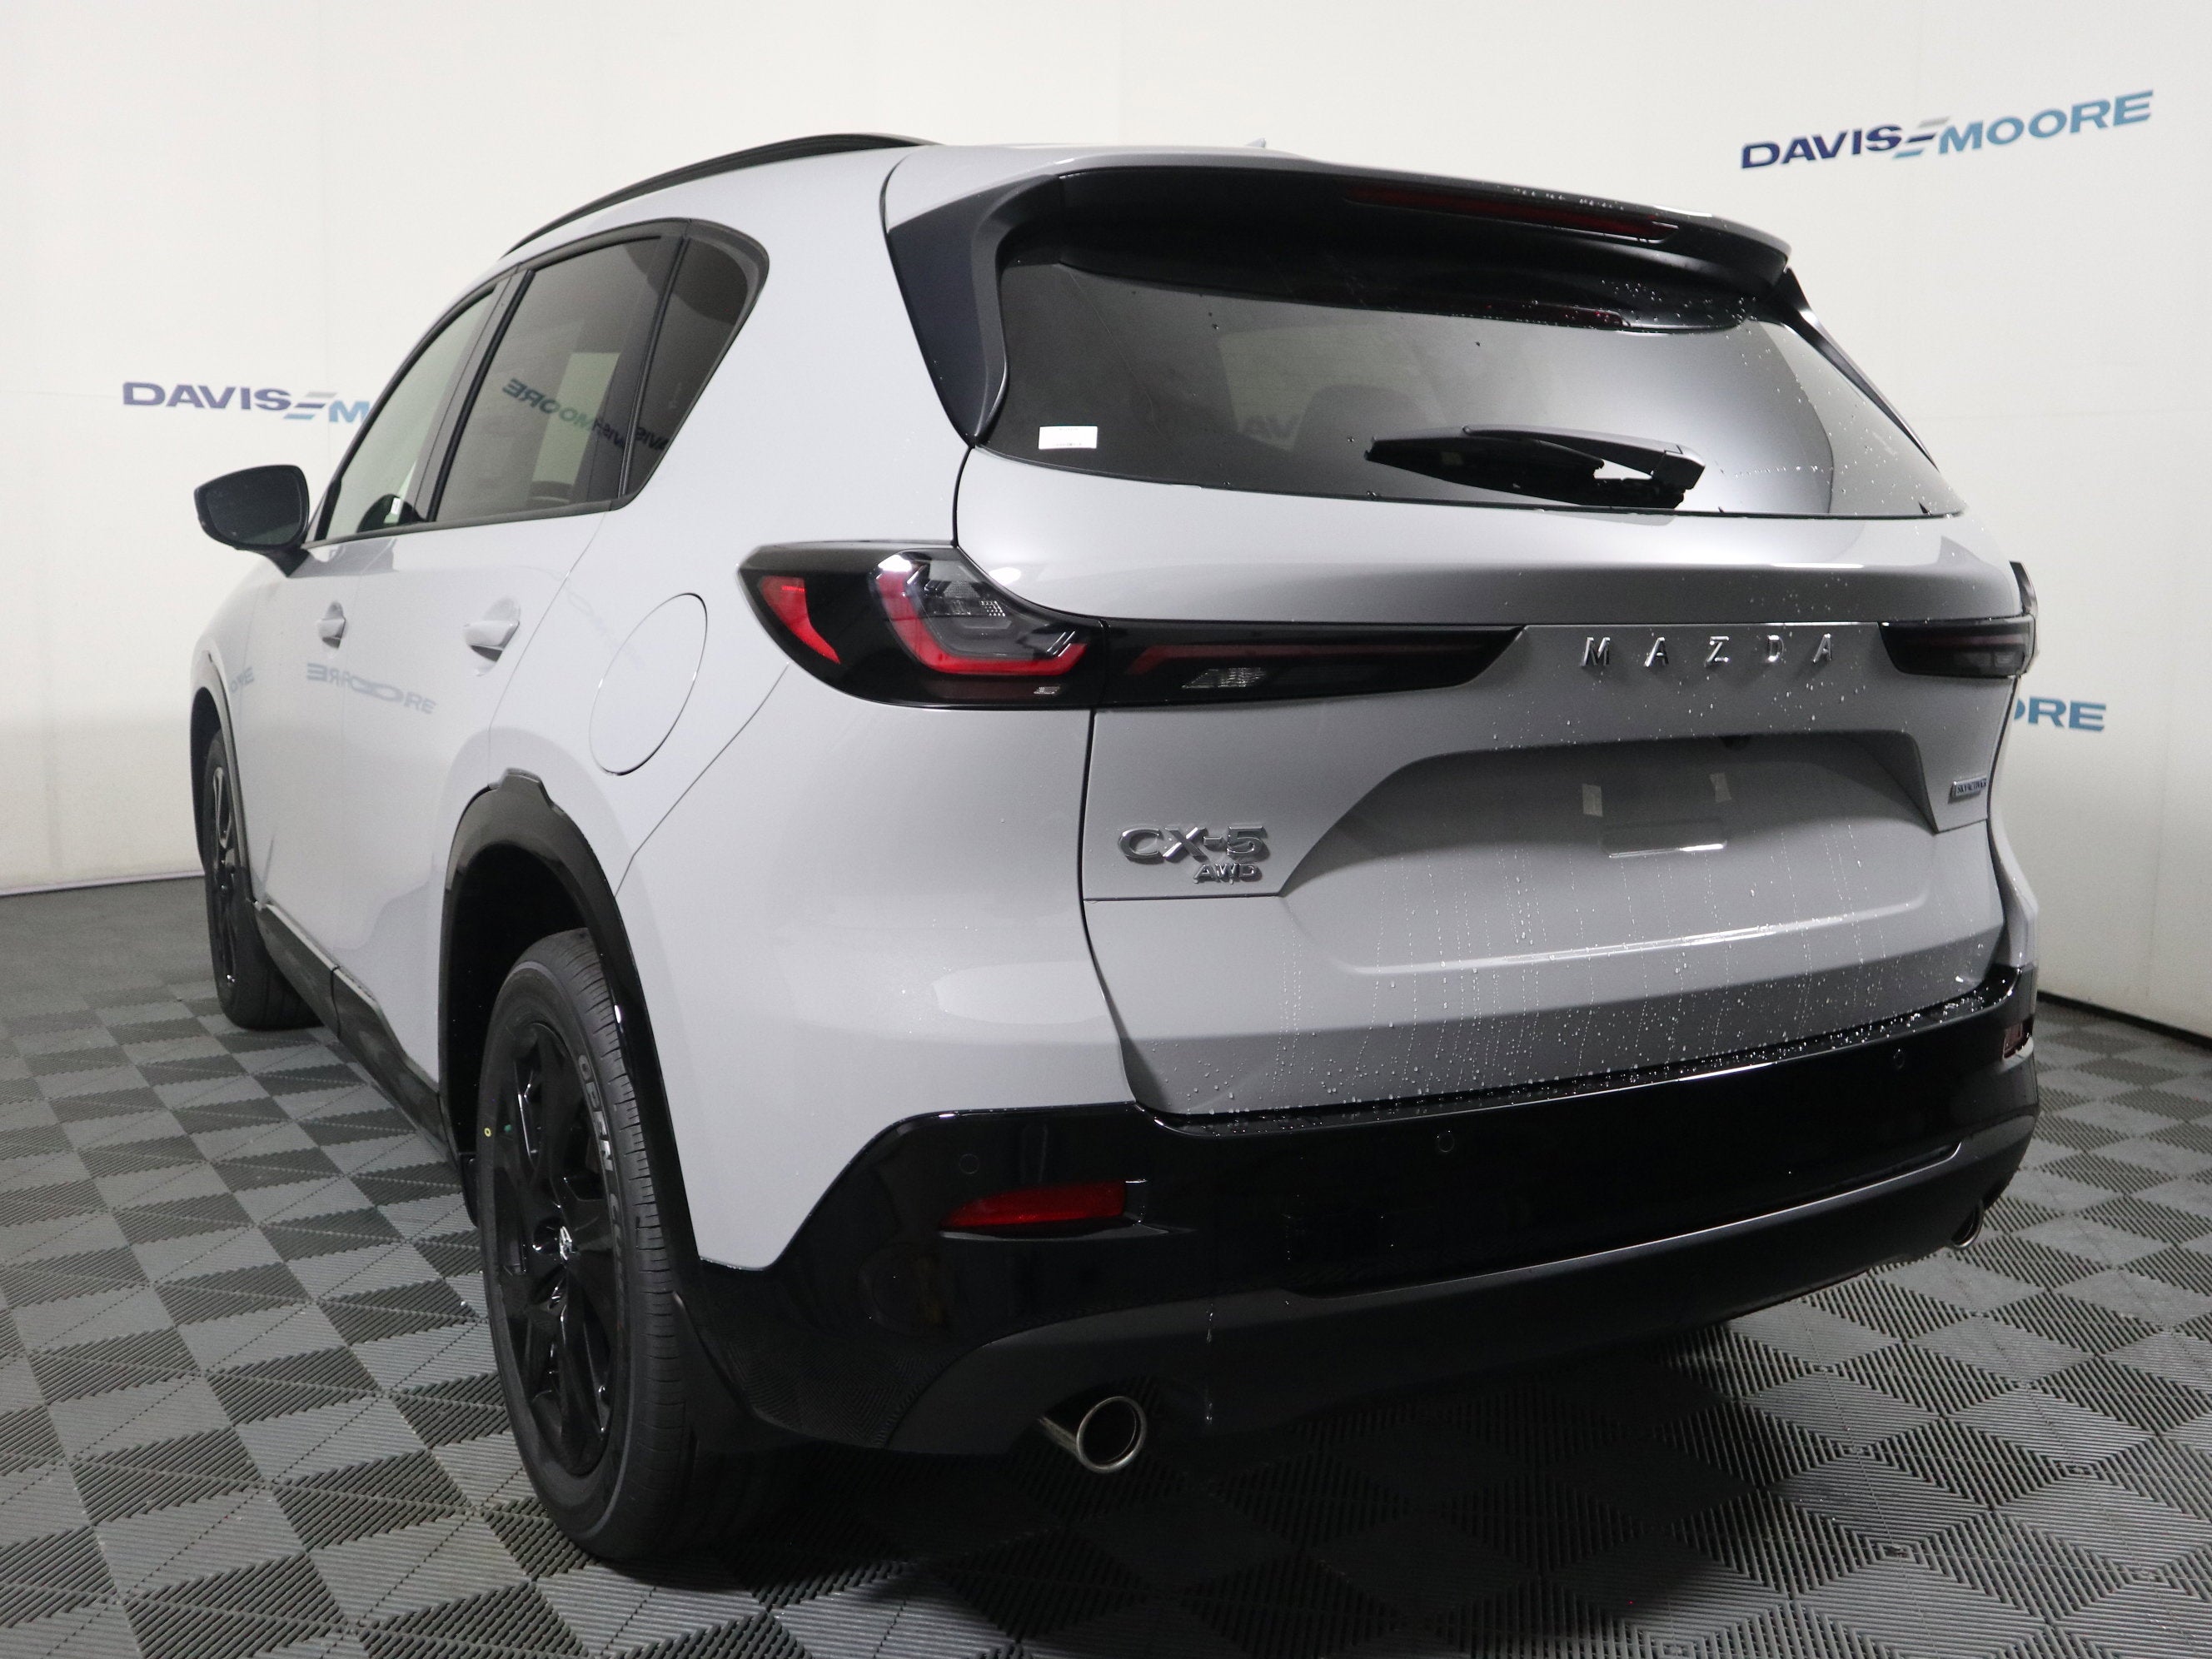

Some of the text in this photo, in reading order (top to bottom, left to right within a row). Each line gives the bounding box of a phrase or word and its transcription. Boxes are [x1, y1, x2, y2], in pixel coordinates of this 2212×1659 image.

[1741, 89, 2155, 169] DAVIS MOORE
[122, 381, 292, 411] DAVIS
[1582, 633, 1832, 668] MAZDA
[2013, 695, 2107, 732] RE
[1118, 825, 1268, 860] CX-5
[1191, 862, 1259, 884] AWD
